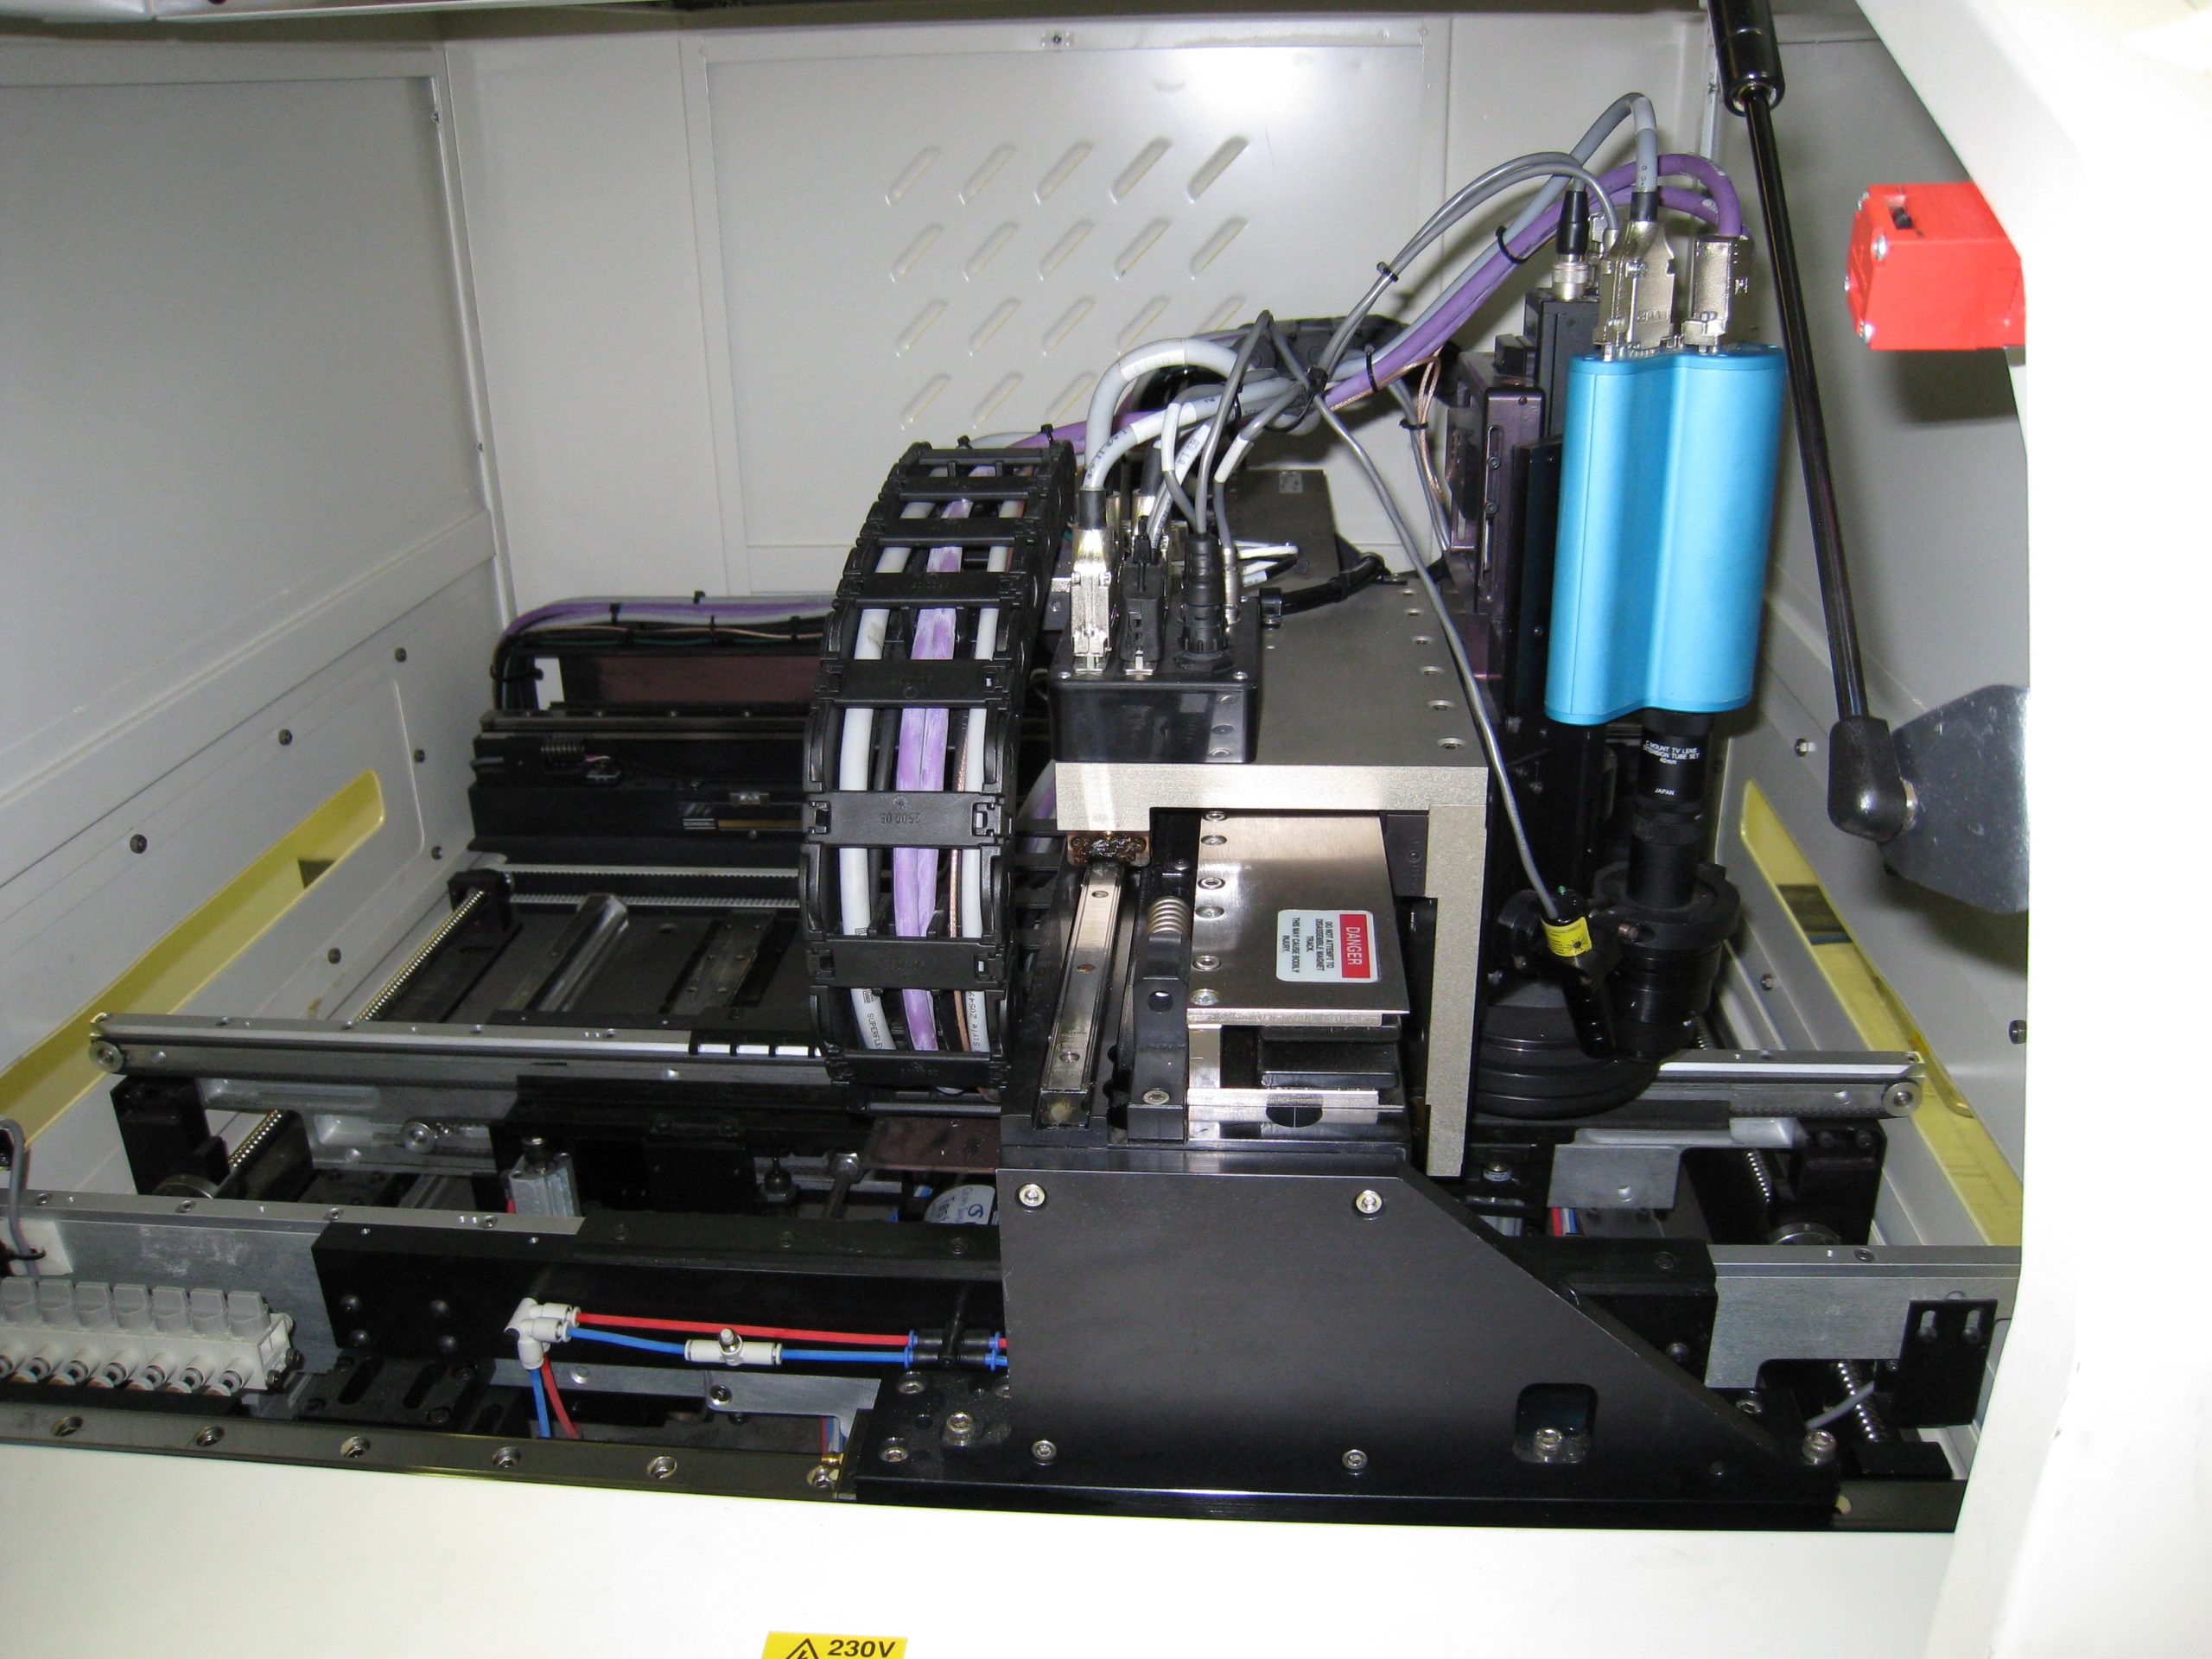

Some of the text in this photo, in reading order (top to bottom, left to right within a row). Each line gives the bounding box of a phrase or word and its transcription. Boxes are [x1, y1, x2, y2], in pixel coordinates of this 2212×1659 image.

[1649, 742, 1670, 752] MOUNT
[1292, 918, 1300, 927] THIS
[1292, 927, 1300, 938] MAY
[1282, 935, 1291, 953] INJURY.
[1315, 918, 1325, 971] DISASSEMBLE MAGNET
[1325, 938, 1334, 961] ATTEMPT
[1345, 926, 1363, 965] DANGER
[1292, 955, 1300, 973] BODILY
[969, 1023, 981, 1046] Style
[827, 1639, 896, 1658] 230V
